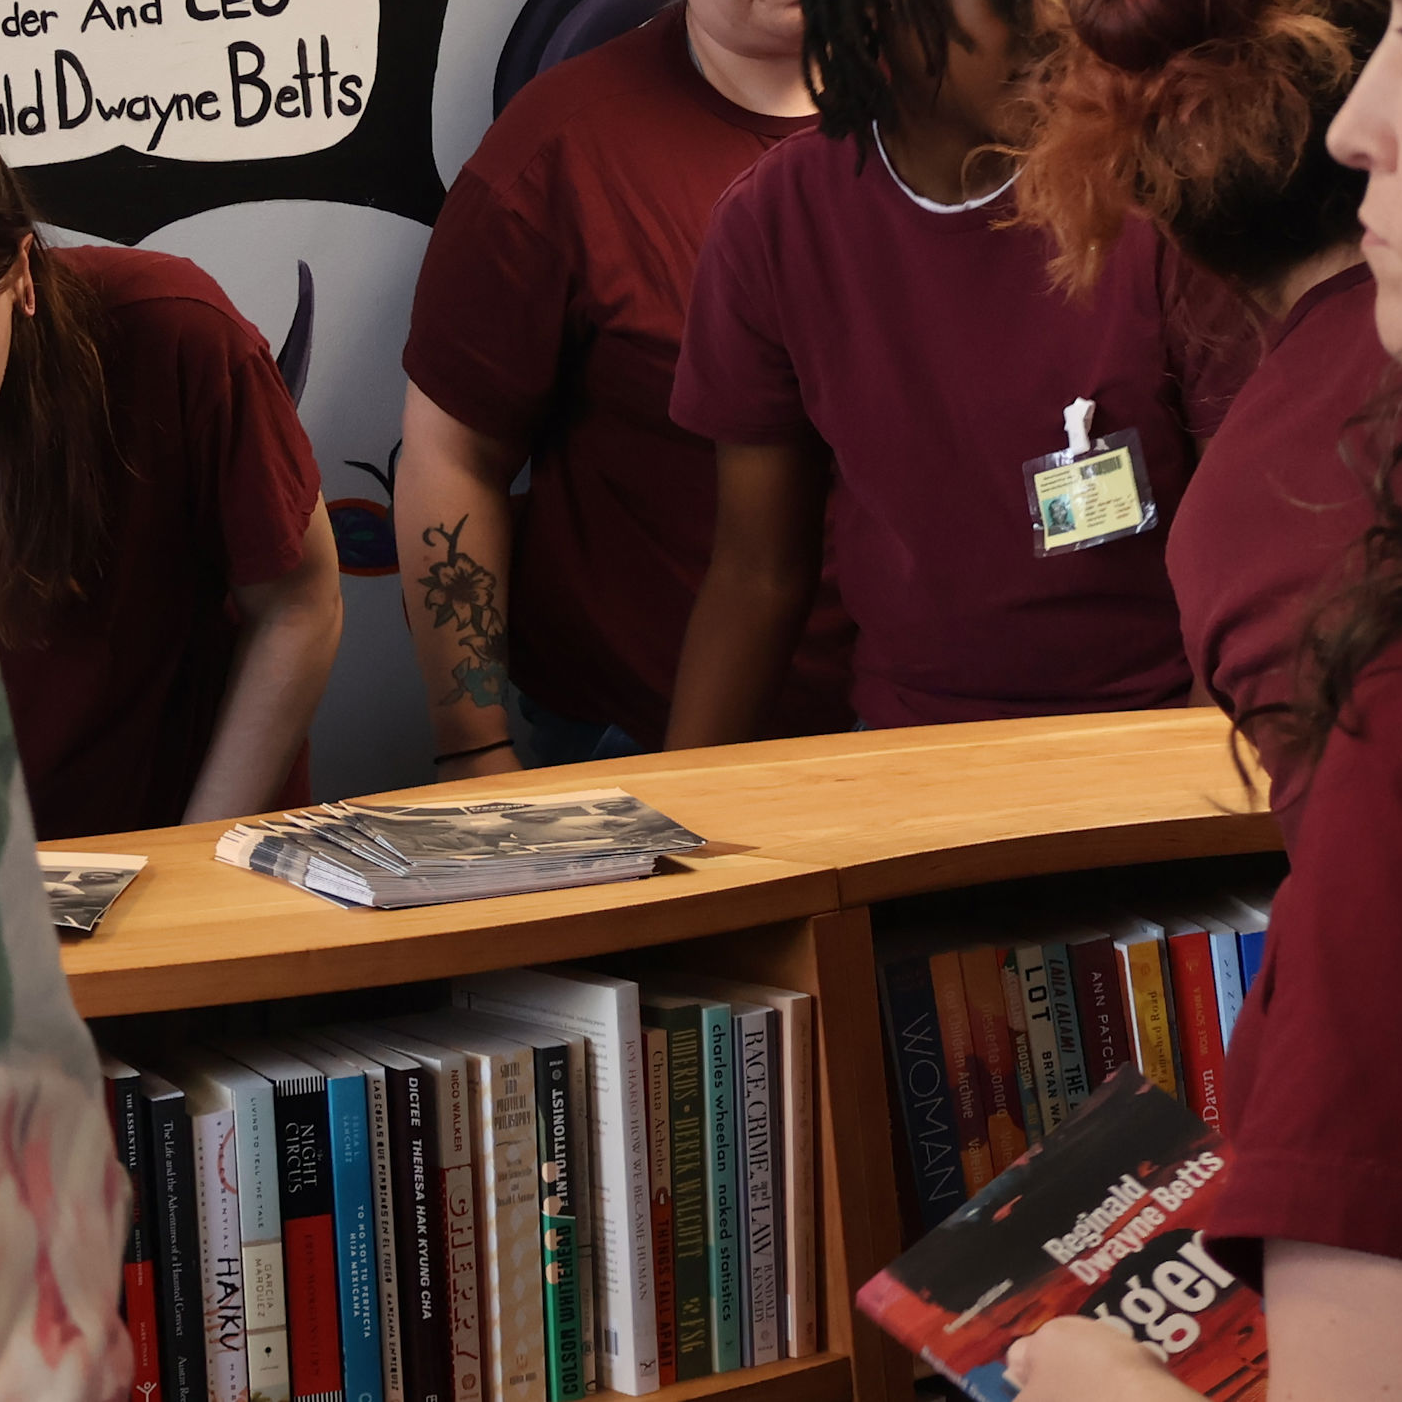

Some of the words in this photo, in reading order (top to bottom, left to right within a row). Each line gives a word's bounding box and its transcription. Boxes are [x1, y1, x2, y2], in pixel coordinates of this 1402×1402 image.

[54, 49, 223, 152] Dwayne
[228, 34, 365, 128] Betts
[1025, 966, 1050, 1024] LOT
[1049, 957, 1067, 997] LAILA
[1091, 971, 1106, 1007] ANN
[1055, 1002, 1076, 1054] LALAMI
[1147, 992, 1161, 1021] Road
[625, 1039, 636, 1064] JOY
[672, 1028, 699, 1101] OMEROS
[711, 1024, 729, 1089] charles
[744, 1030, 766, 1099] RACE,
[946, 1011, 969, 1068] Children
[1015, 1035, 1034, 1089] WOODSON
[1098, 1014, 1116, 1075] PATCH
[373, 1079, 382, 1100] LAS
[450, 1069, 461, 1099] NICO
[652, 1050, 666, 1111] Chinua
[955, 1071, 975, 1119] Archive
[989, 1068, 1011, 1119] sonoro
[1042, 1051, 1058, 1098] BRYAN
[1064, 1064, 1084, 1095] THE
[1202, 1068, 1220, 1122] Dawn
[250, 1097, 259, 1131] LIVING
[374, 1103, 384, 1138] COSAS
[408, 1077, 421, 1126] DICTEE
[452, 1101, 463, 1153] WALKER
[901, 1011, 960, 1203] WOMAN
[1049, 1104, 1062, 1127] WA
[126, 1112, 137, 1168] ESSENTIAL
[163, 1120, 175, 1140] The
[164, 1141, 176, 1158] Life
[253, 1136, 260, 1148] TO
[300, 1123, 318, 1186] NIGHT
[377, 1142, 385, 1160] QUE
[552, 1088, 568, 1198] INTUITIONIST
[629, 1119, 642, 1154] HOW
[653, 1118, 668, 1177] Achebe
[673, 1117, 701, 1175] DEREK
[713, 1095, 731, 1172] wheelan
[746, 1101, 770, 1181] CRIME,
[165, 1160, 177, 1176] and
[284, 1121, 304, 1193] CIRCUS
[411, 1139, 425, 1201] THERESA
[631, 1158, 643, 1183] WE
[167, 1177, 178, 1192] the
[167, 1194, 181, 1244] Adventures
[256, 1205, 264, 1229] TALE
[357, 1204, 365, 1219] YO
[358, 1224, 365, 1239] NO
[381, 1220, 389, 1234] EN
[415, 1205, 428, 1234] HAK
[632, 1184, 646, 1244] BECAME
[675, 1178, 704, 1259] WALCOTT
[717, 1184, 733, 1240] naked
[750, 1204, 772, 1259] LAW
[1042, 1173, 1150, 1267] Reginald
[1068, 1201, 1167, 1287] Dwayne
[1150, 1148, 1226, 1217] Betts
[170, 1245, 182, 1255] of
[359, 1243, 367, 1263] SOY
[382, 1239, 390, 1249] EL
[383, 1253, 392, 1284] FUEGO
[417, 1238, 430, 1286] KYUNG
[656, 1219, 673, 1276] THINGS
[350, 1261, 361, 1318] MEXICANA
[361, 1268, 368, 1281] TU
[449, 1185, 479, 1361] CHERRY
[556, 1225, 574, 1324] WHITEHEAD
[635, 1246, 648, 1300] HUMAN
[658, 1281, 673, 1317] FALL
[719, 1246, 735, 1322] statistics
[752, 1266, 765, 1324] KENNEDY
[763, 1263, 776, 1323] RANDALL
[173, 1302, 185, 1337] Convict
[216, 1257, 245, 1352] HAIKU
[361, 1285, 371, 1338] PERFECTA
[421, 1290, 432, 1320] CHA
[562, 1330, 578, 1396] COLSON
[659, 1321, 674, 1368] APART
